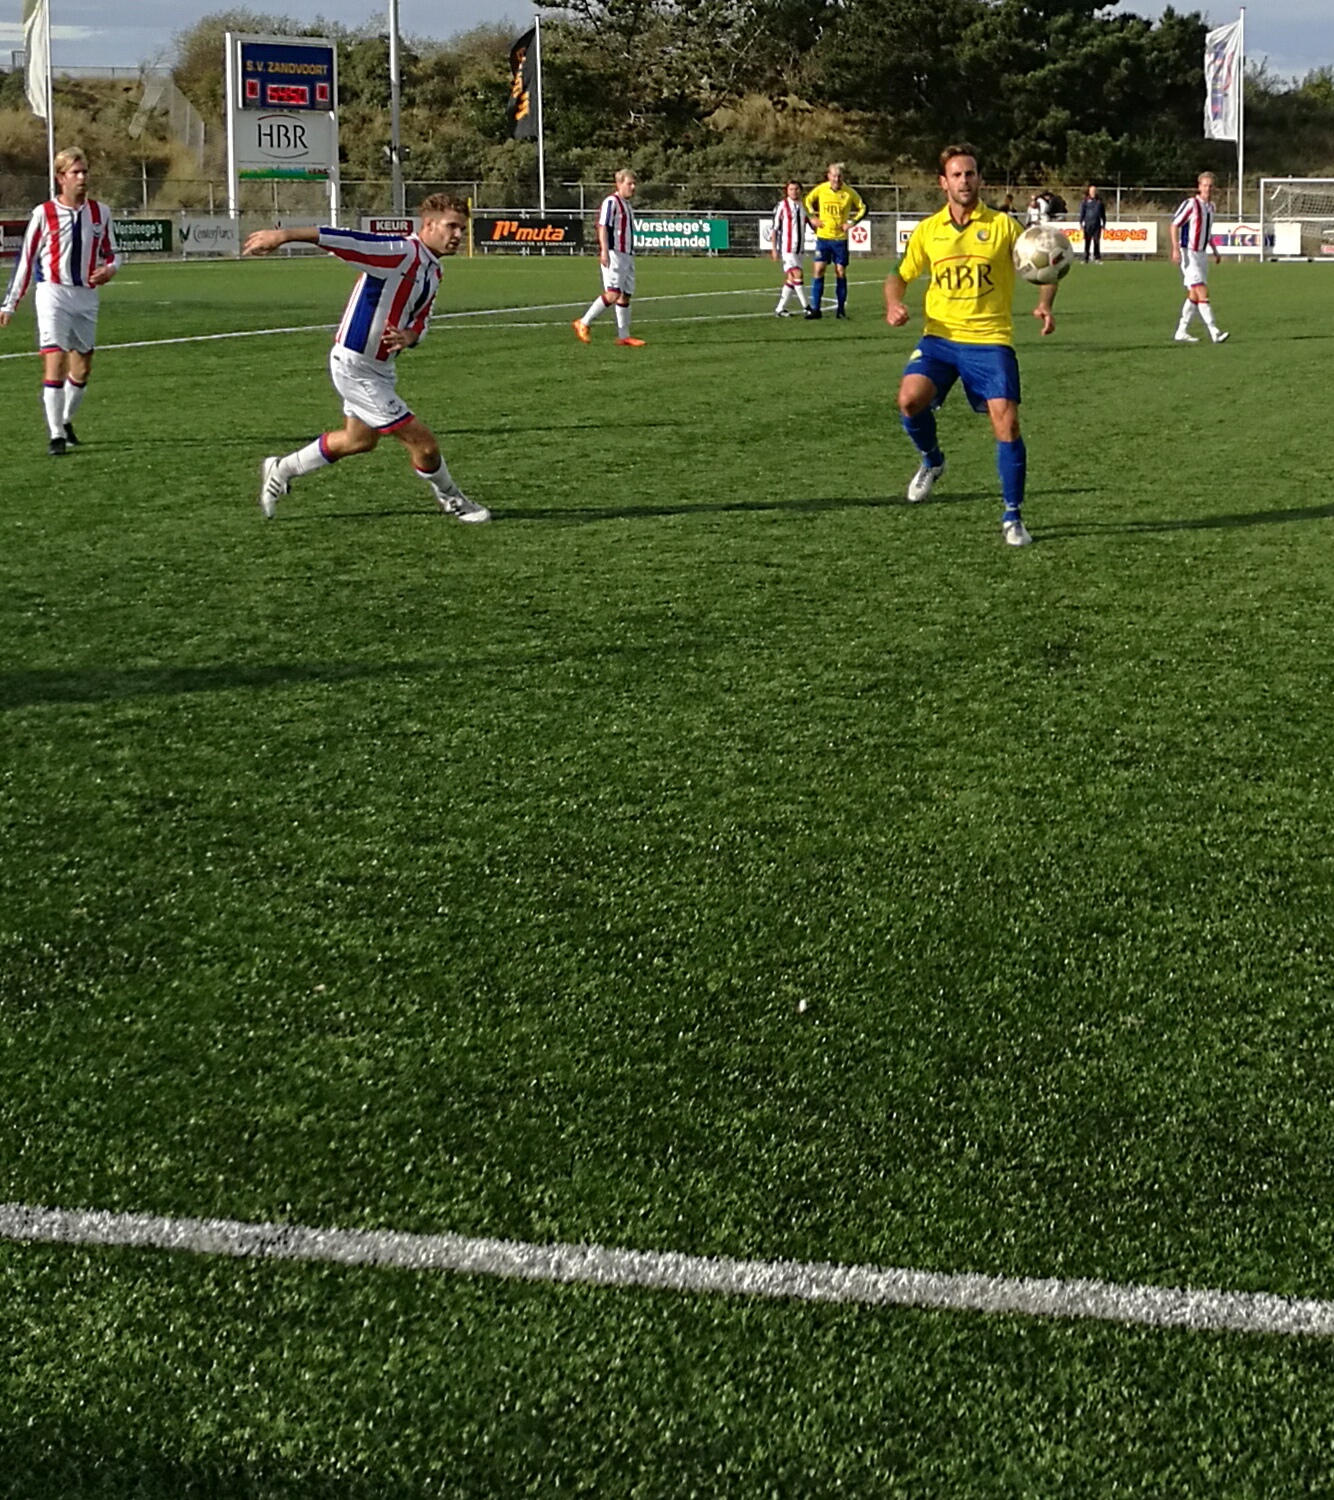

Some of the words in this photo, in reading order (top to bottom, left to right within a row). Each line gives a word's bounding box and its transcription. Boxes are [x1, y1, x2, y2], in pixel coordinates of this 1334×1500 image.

[245, 60, 266, 72] S.V.
[267, 61, 329, 75] ZANDVOORT
[257, 123, 308, 149] HBR
[114, 221, 163, 237] Versteege's
[374, 220, 409, 231] KEUR
[515, 224, 565, 241] muta
[634, 219, 711, 235] Versteege's
[634, 234, 711, 248] IJzerhandel
[1103, 229, 1148, 242] KONG
[118, 238, 163, 250] Jzerhandel
[935, 263, 995, 290] HBR
